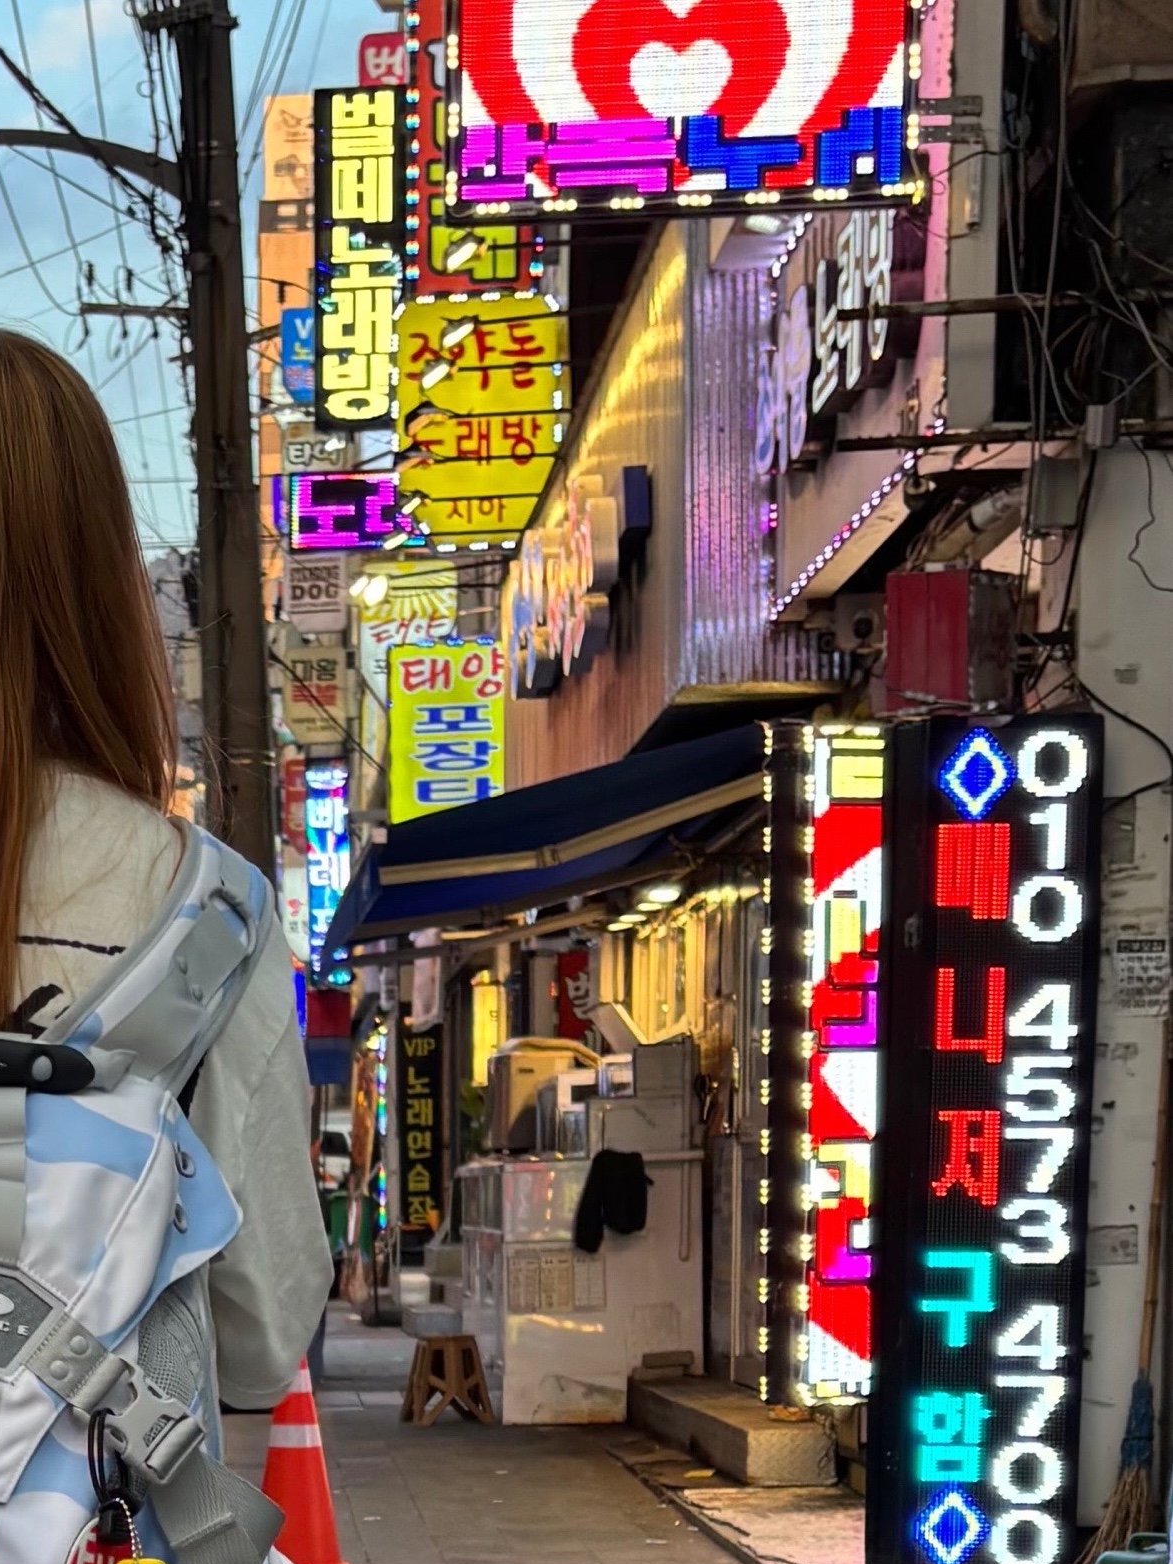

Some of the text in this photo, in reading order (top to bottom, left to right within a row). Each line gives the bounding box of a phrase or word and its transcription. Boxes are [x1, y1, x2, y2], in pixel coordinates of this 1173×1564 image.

[291, 583, 340, 601] DOG
[399, 648, 503, 698] 태양
[1012, 730, 1089, 942] 010
[404, 1036, 436, 1057] VIP
[917, 823, 1011, 1481] 매니저 구함
[1000, 984, 1078, 1264] 4573
